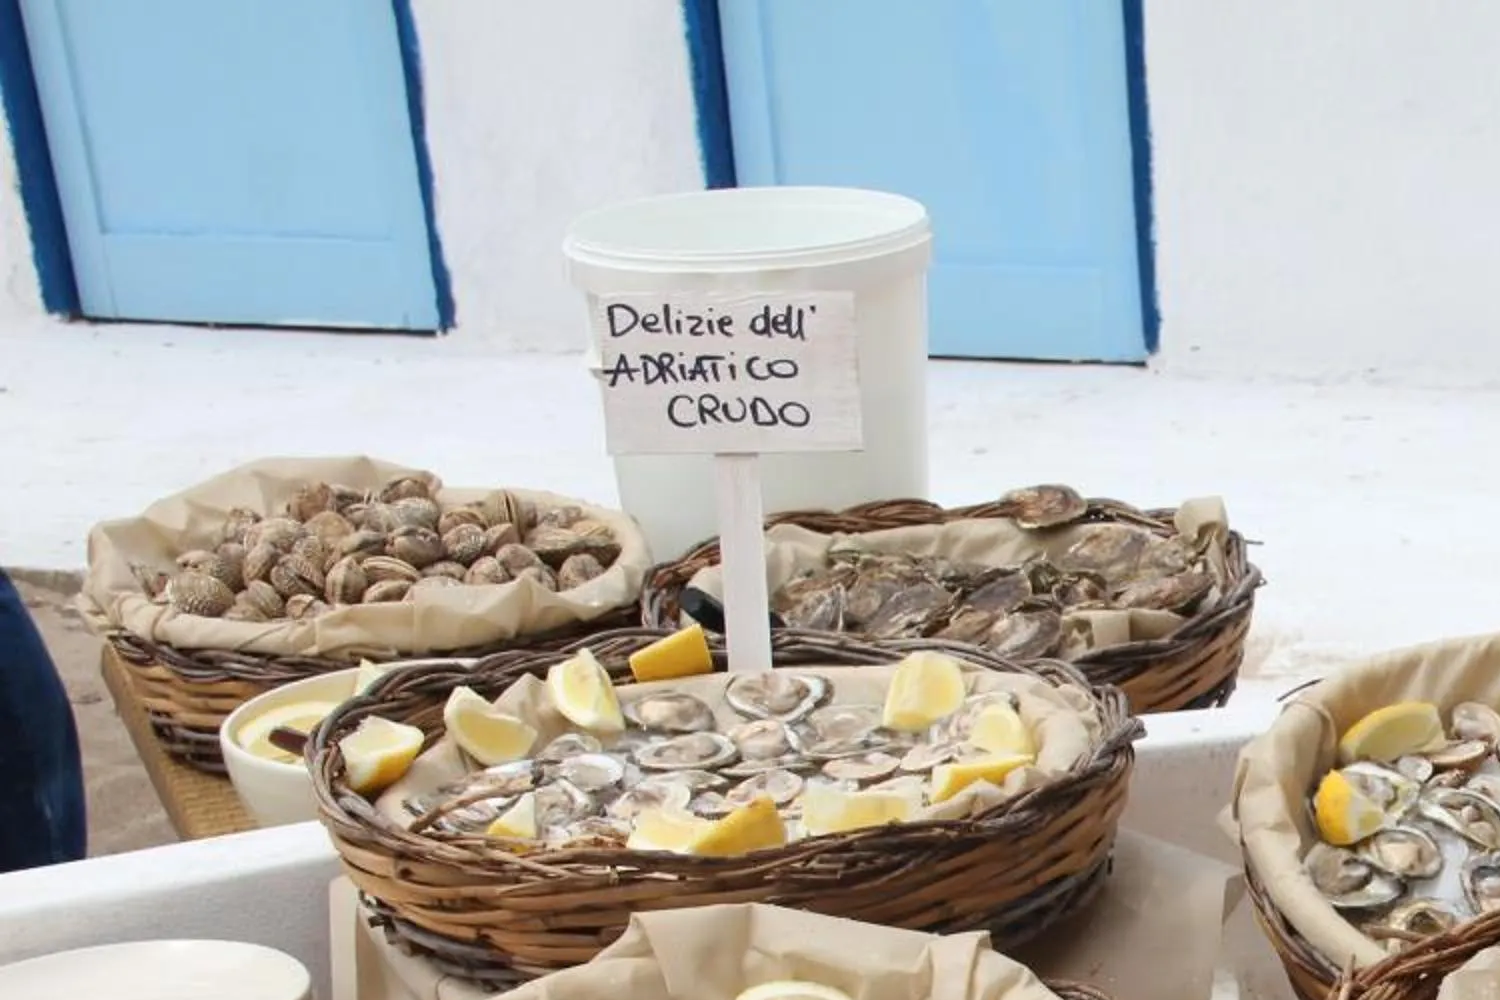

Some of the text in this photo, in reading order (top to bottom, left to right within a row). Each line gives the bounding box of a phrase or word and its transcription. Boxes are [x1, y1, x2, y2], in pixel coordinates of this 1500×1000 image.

[606, 302, 817, 342] Delizie dell'
[666, 392, 811, 429] CRUDO
